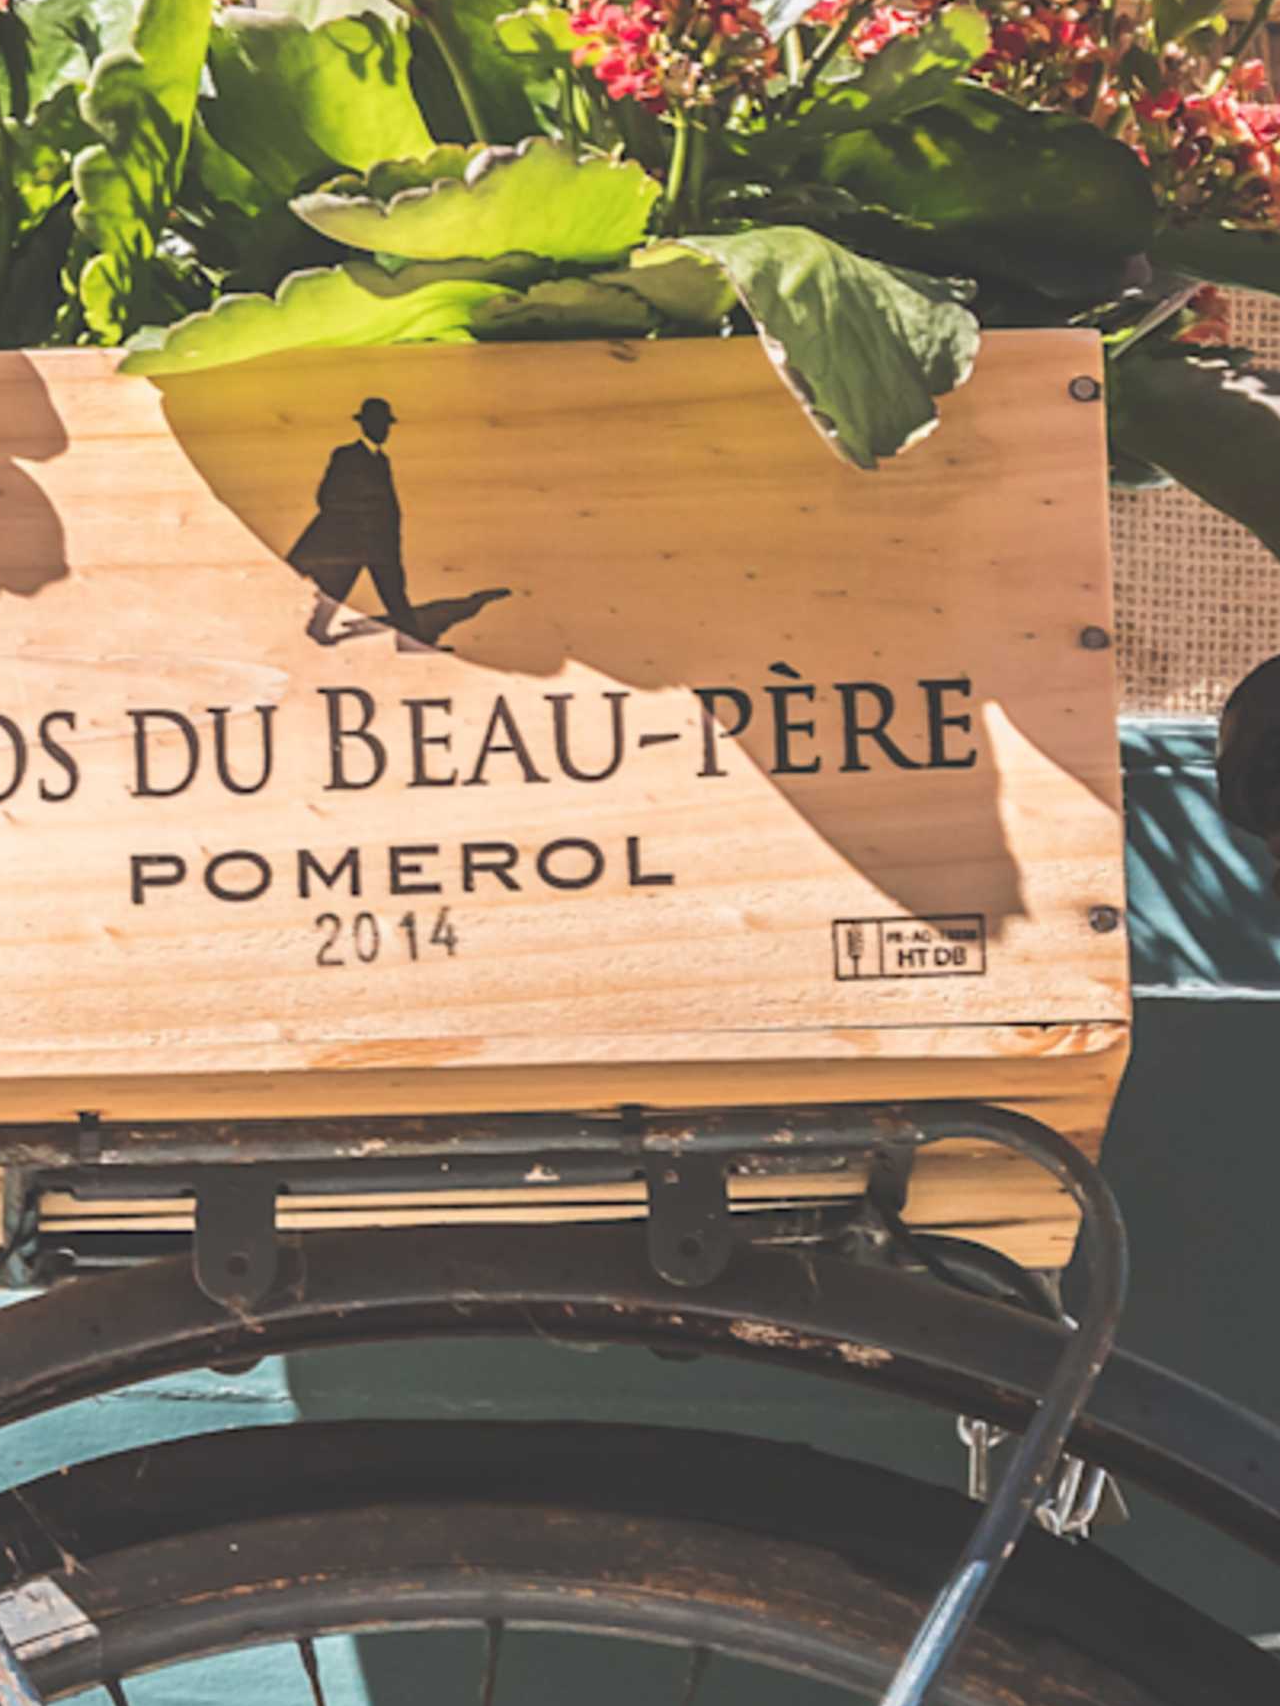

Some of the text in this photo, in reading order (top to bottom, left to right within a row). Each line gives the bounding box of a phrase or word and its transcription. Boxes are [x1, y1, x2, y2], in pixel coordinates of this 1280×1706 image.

[126, 705, 279, 797] DU
[316, 662, 979, 791] BEAU-PÈRE
[129, 836, 675, 905] POMEROL
[315, 907, 459, 967] 2014
[898, 946, 967, 968] HT DB
